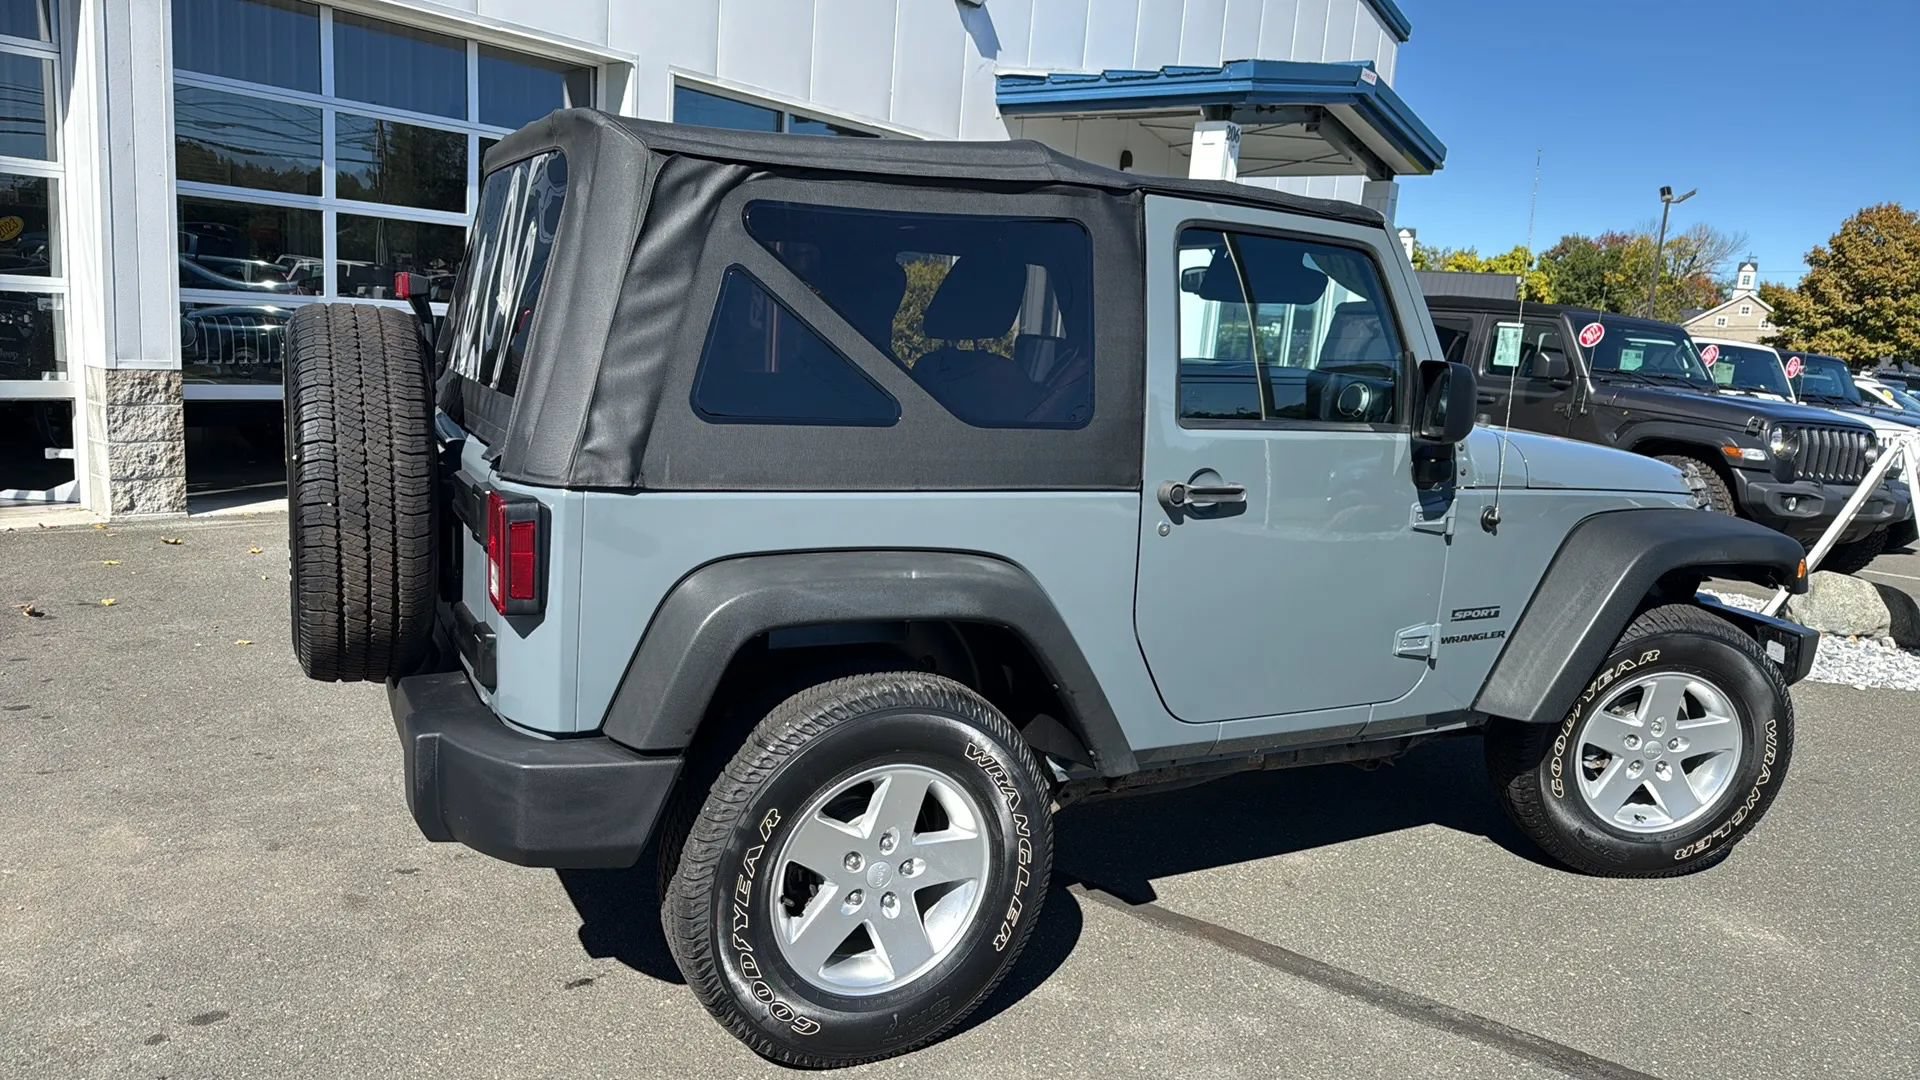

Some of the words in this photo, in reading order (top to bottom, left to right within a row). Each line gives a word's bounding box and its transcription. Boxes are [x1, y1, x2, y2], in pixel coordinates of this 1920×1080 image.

[1225, 124, 1240, 143] 206
[1440, 630, 1506, 645] WRANGLER
[1453, 607, 1498, 619] SPORT
[1551, 649, 1661, 799] GOODYEAR
[1674, 719, 1777, 860] WRANGLER
[964, 742, 1032, 951] WRANGLER
[733, 808, 821, 1035] GOODYEAR
